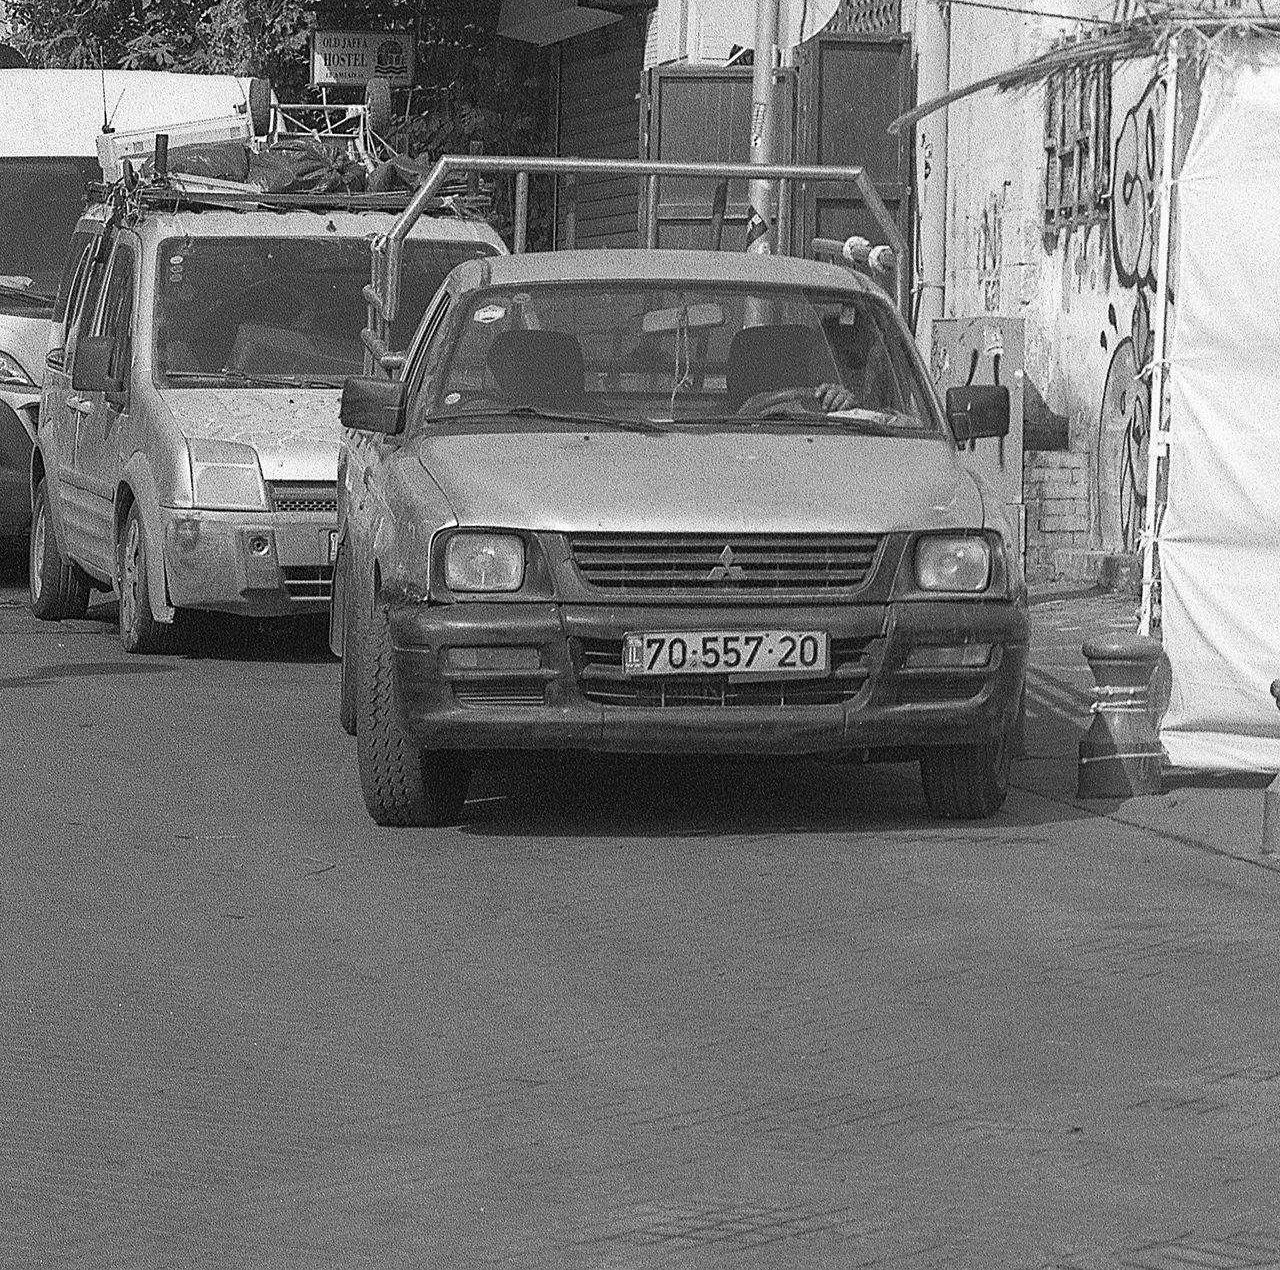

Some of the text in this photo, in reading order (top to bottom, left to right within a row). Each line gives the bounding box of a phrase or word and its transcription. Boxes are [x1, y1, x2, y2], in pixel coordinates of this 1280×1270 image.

[323, 37, 368, 49] OLD JAFFA
[324, 53, 367, 67] HOSTEL
